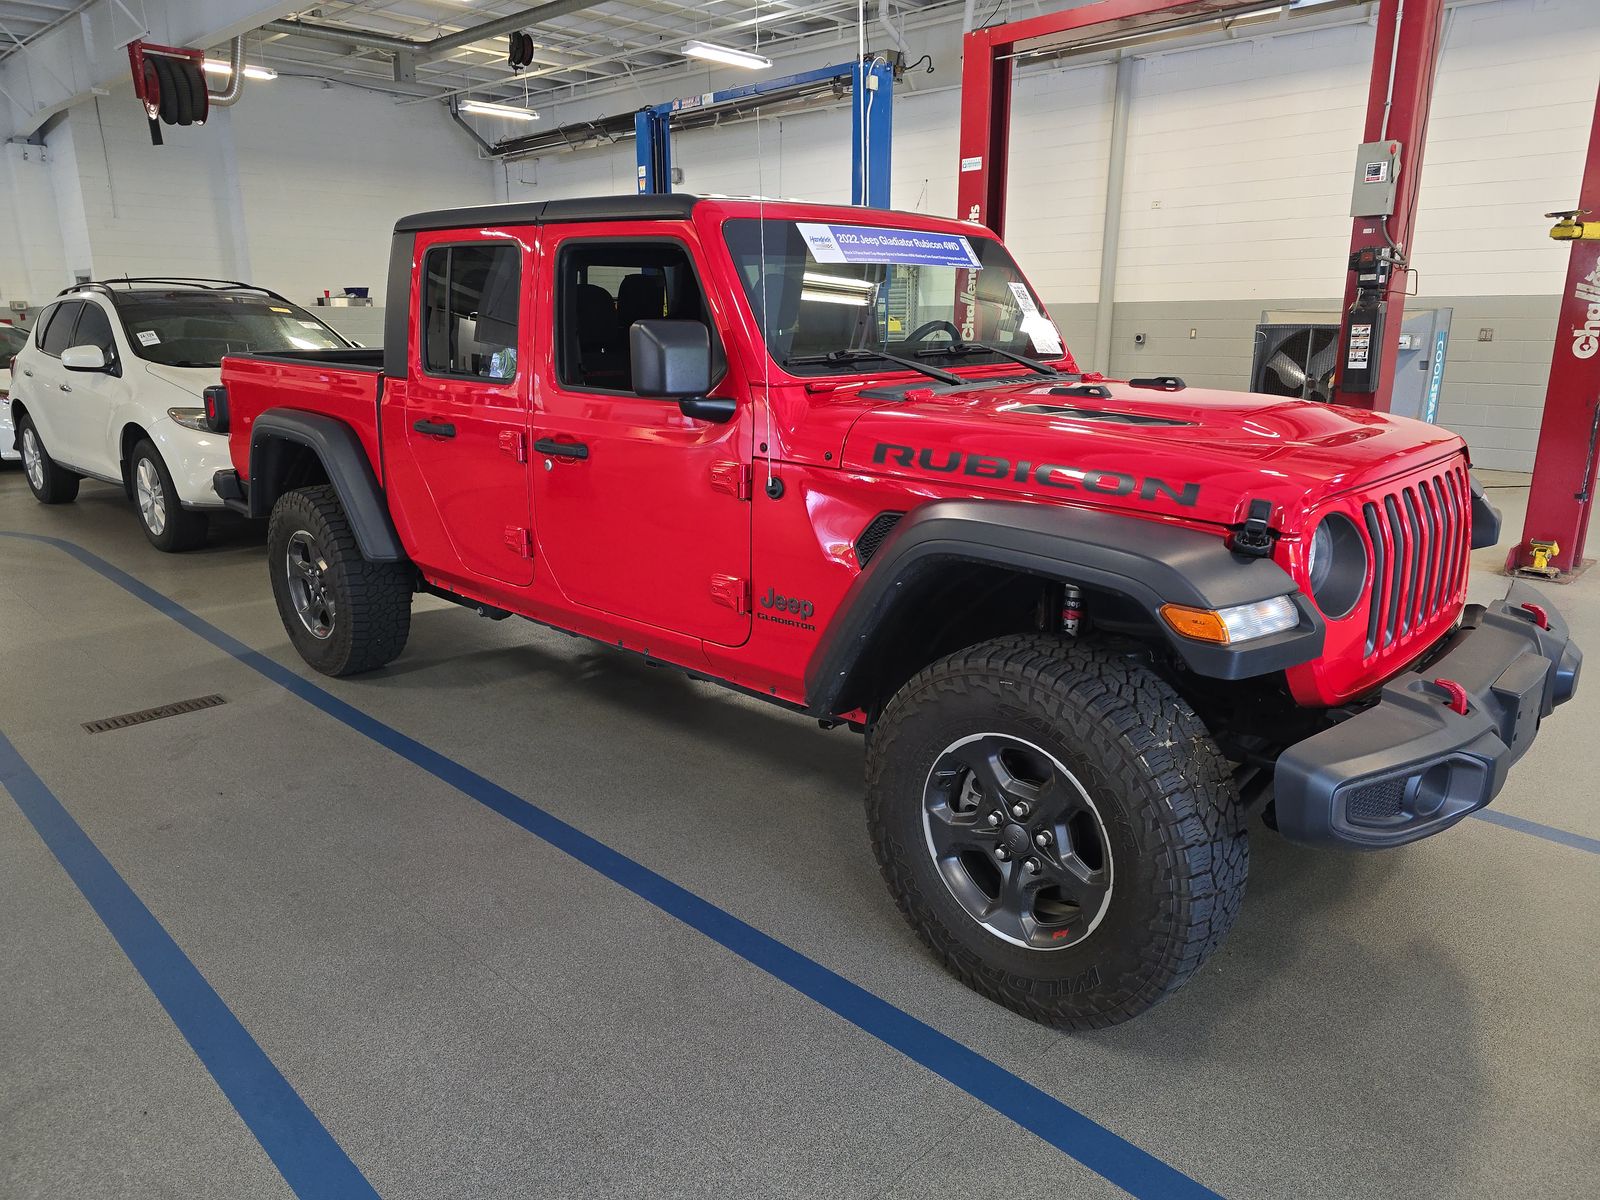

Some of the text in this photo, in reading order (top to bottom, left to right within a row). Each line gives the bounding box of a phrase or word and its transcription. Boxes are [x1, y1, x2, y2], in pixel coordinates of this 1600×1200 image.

[836, 233, 960, 251] 2022 Jeep Gladiator Rubicon 4WD
[871, 442, 1202, 508] RUBICON
[760, 587, 815, 620] Jeep
[757, 612, 817, 632] GLADIATOR
